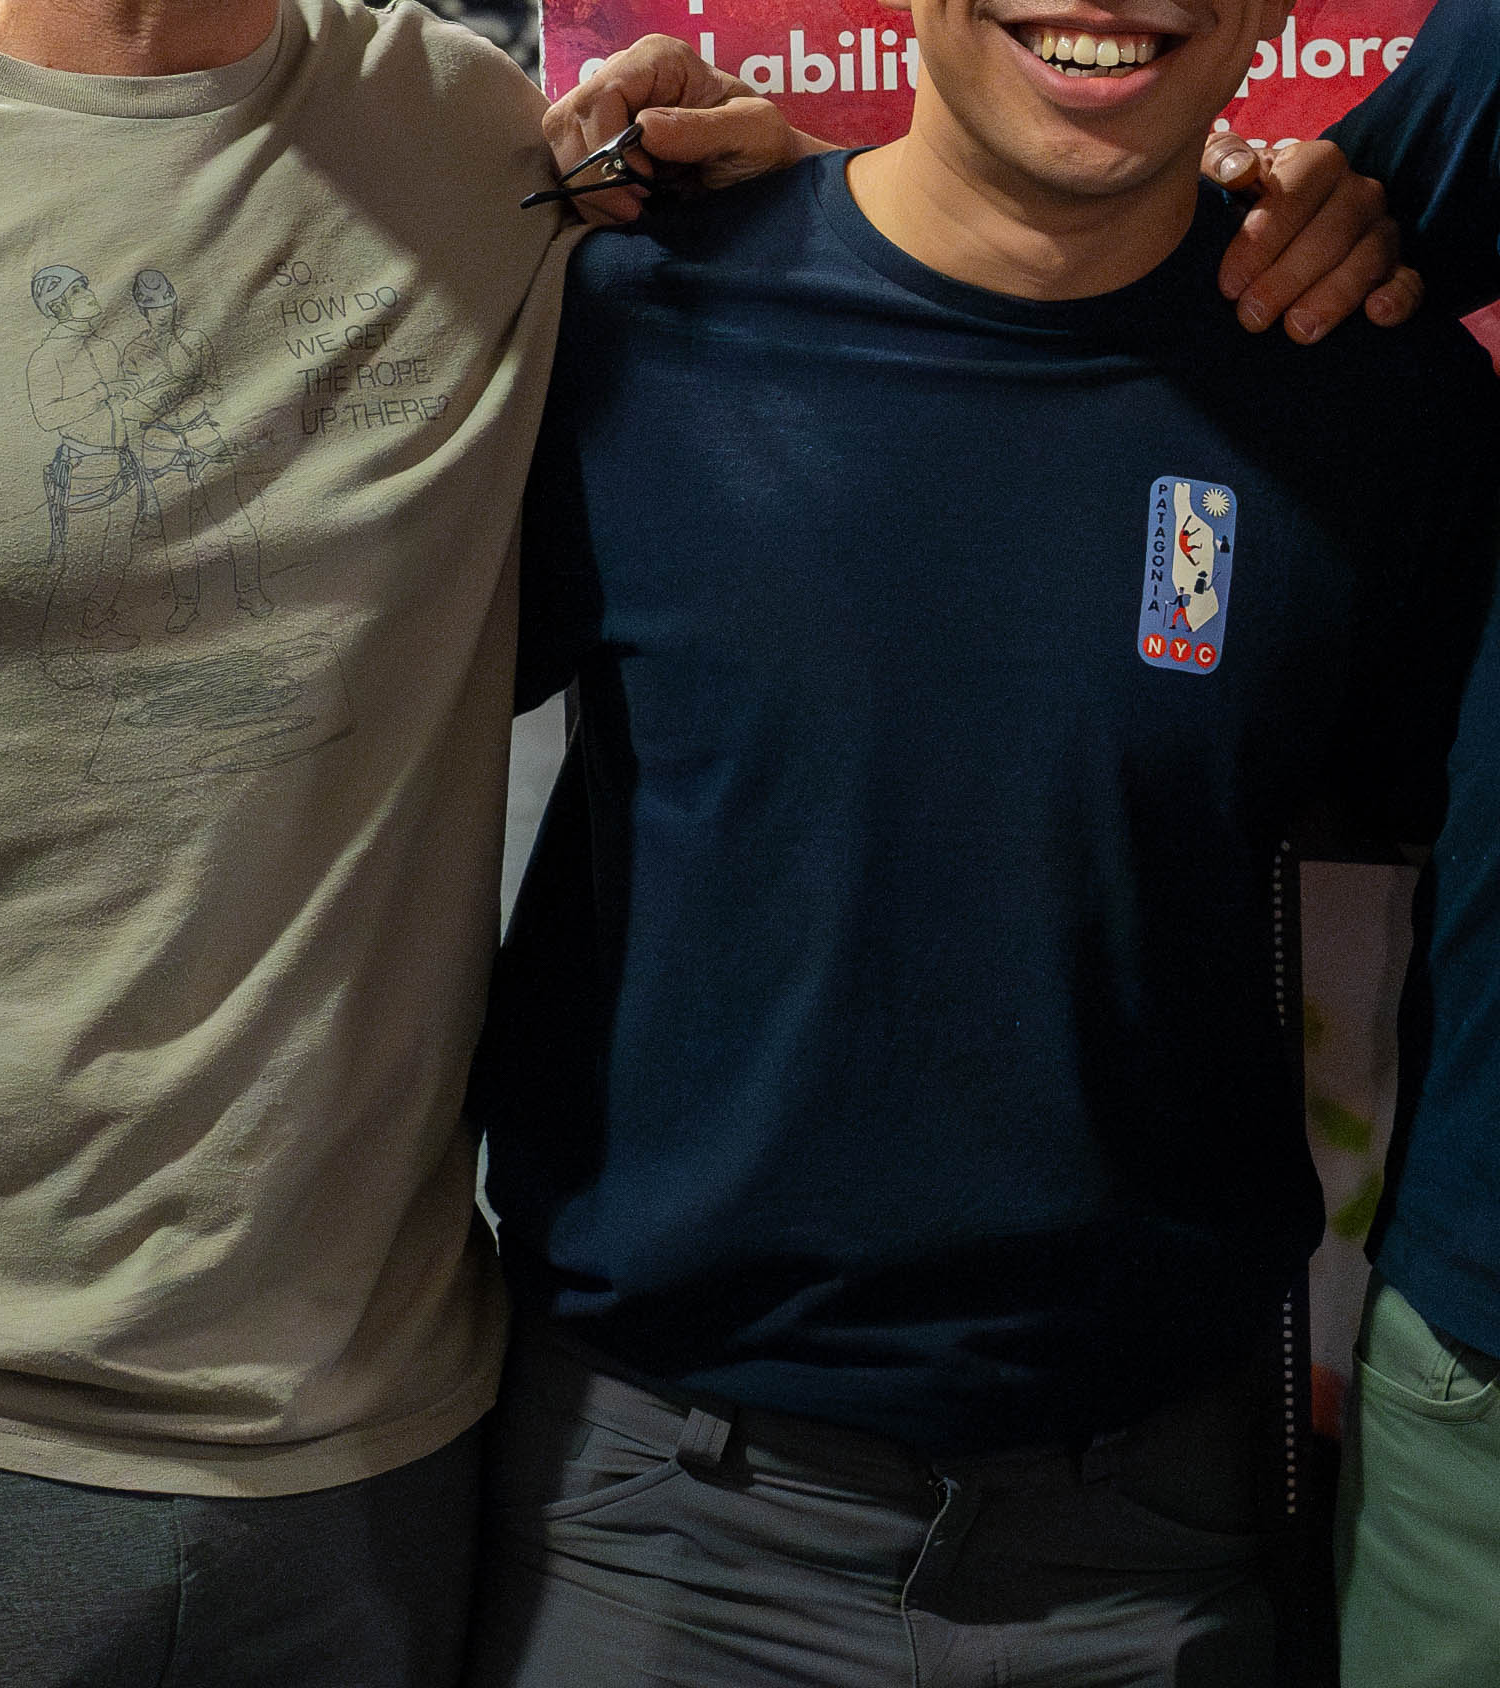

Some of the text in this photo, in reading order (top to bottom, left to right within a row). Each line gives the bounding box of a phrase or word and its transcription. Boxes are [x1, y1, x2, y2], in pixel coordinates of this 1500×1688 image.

[739, 27, 919, 95] abilit
[1234, 15, 1416, 98] plore
[274, 261, 335, 288] SO...
[281, 286, 398, 328] HOW DO
[284, 322, 391, 360] WE GET
[297, 358, 432, 395] THE ROPE
[301, 393, 450, 435] UP THERE?
[1147, 483, 1168, 613] PATAGONIA
[1147, 637, 1214, 664] NYC
